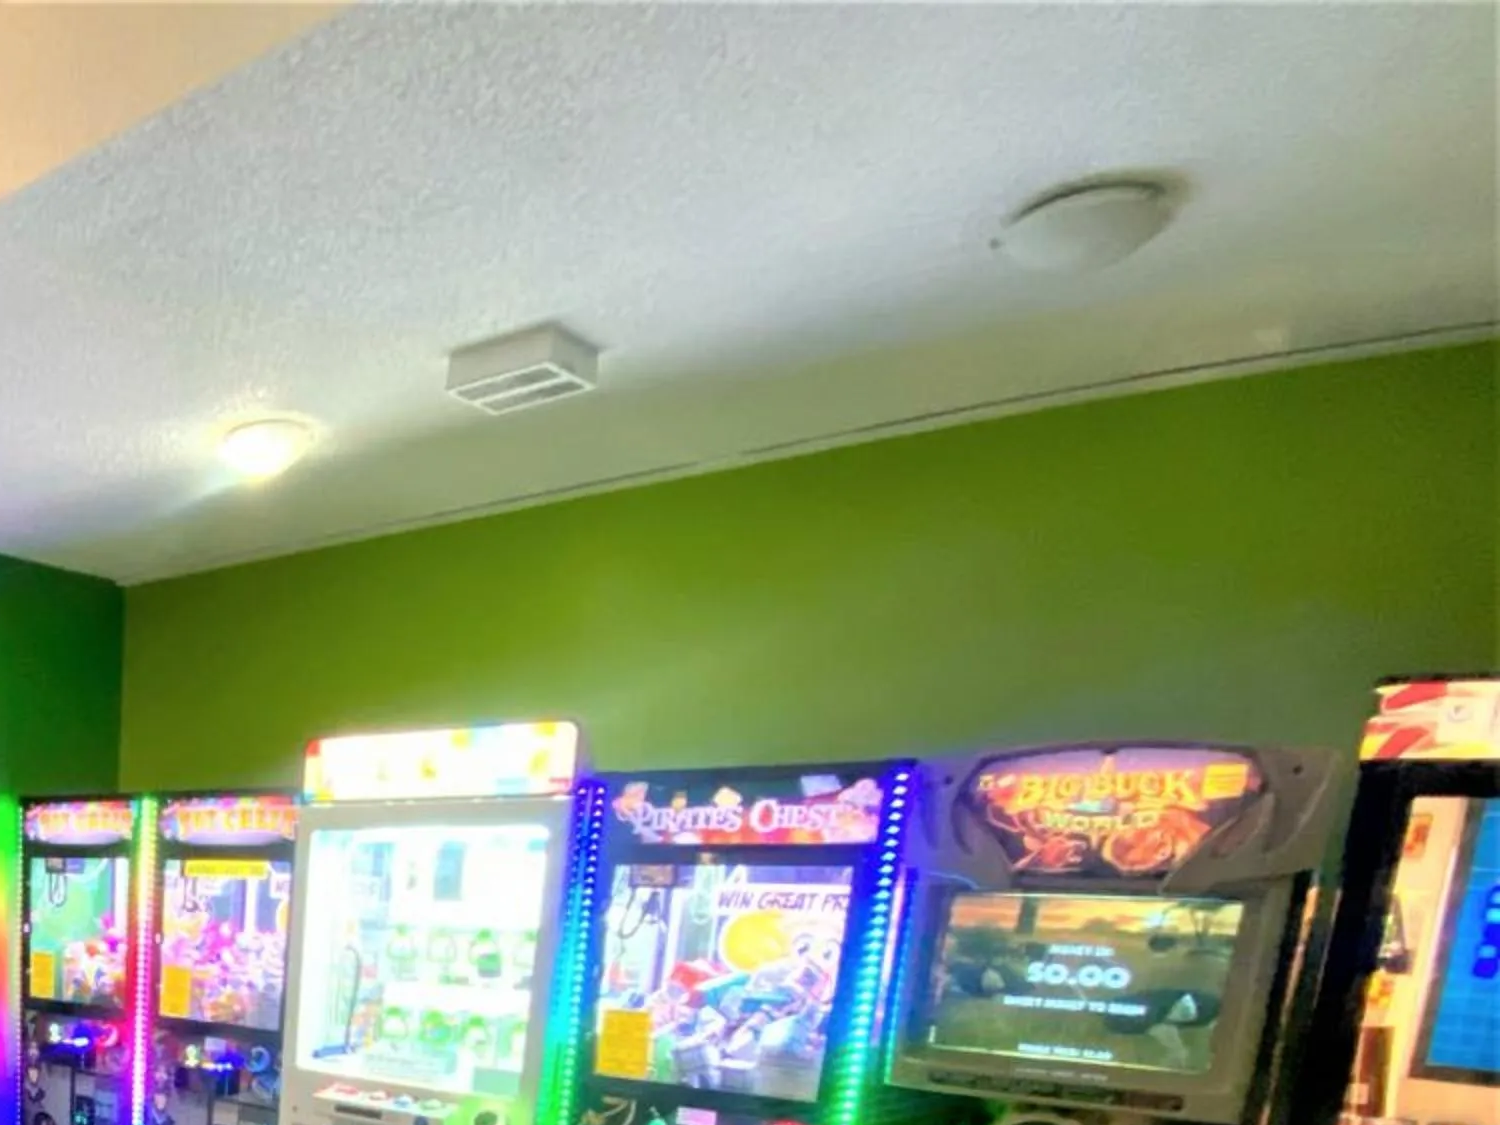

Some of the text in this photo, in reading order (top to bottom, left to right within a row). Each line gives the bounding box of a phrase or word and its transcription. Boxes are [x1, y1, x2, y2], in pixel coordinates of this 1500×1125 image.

[1016, 774, 1082, 808] BIG
[1089, 769, 1197, 803] BUCK
[750, 798, 841, 833] CHEST
[1044, 810, 1161, 831] WORLD
[717, 890, 754, 909] WIN
[756, 890, 820, 910] GREAT
[1026, 961, 1132, 989] $0.00
